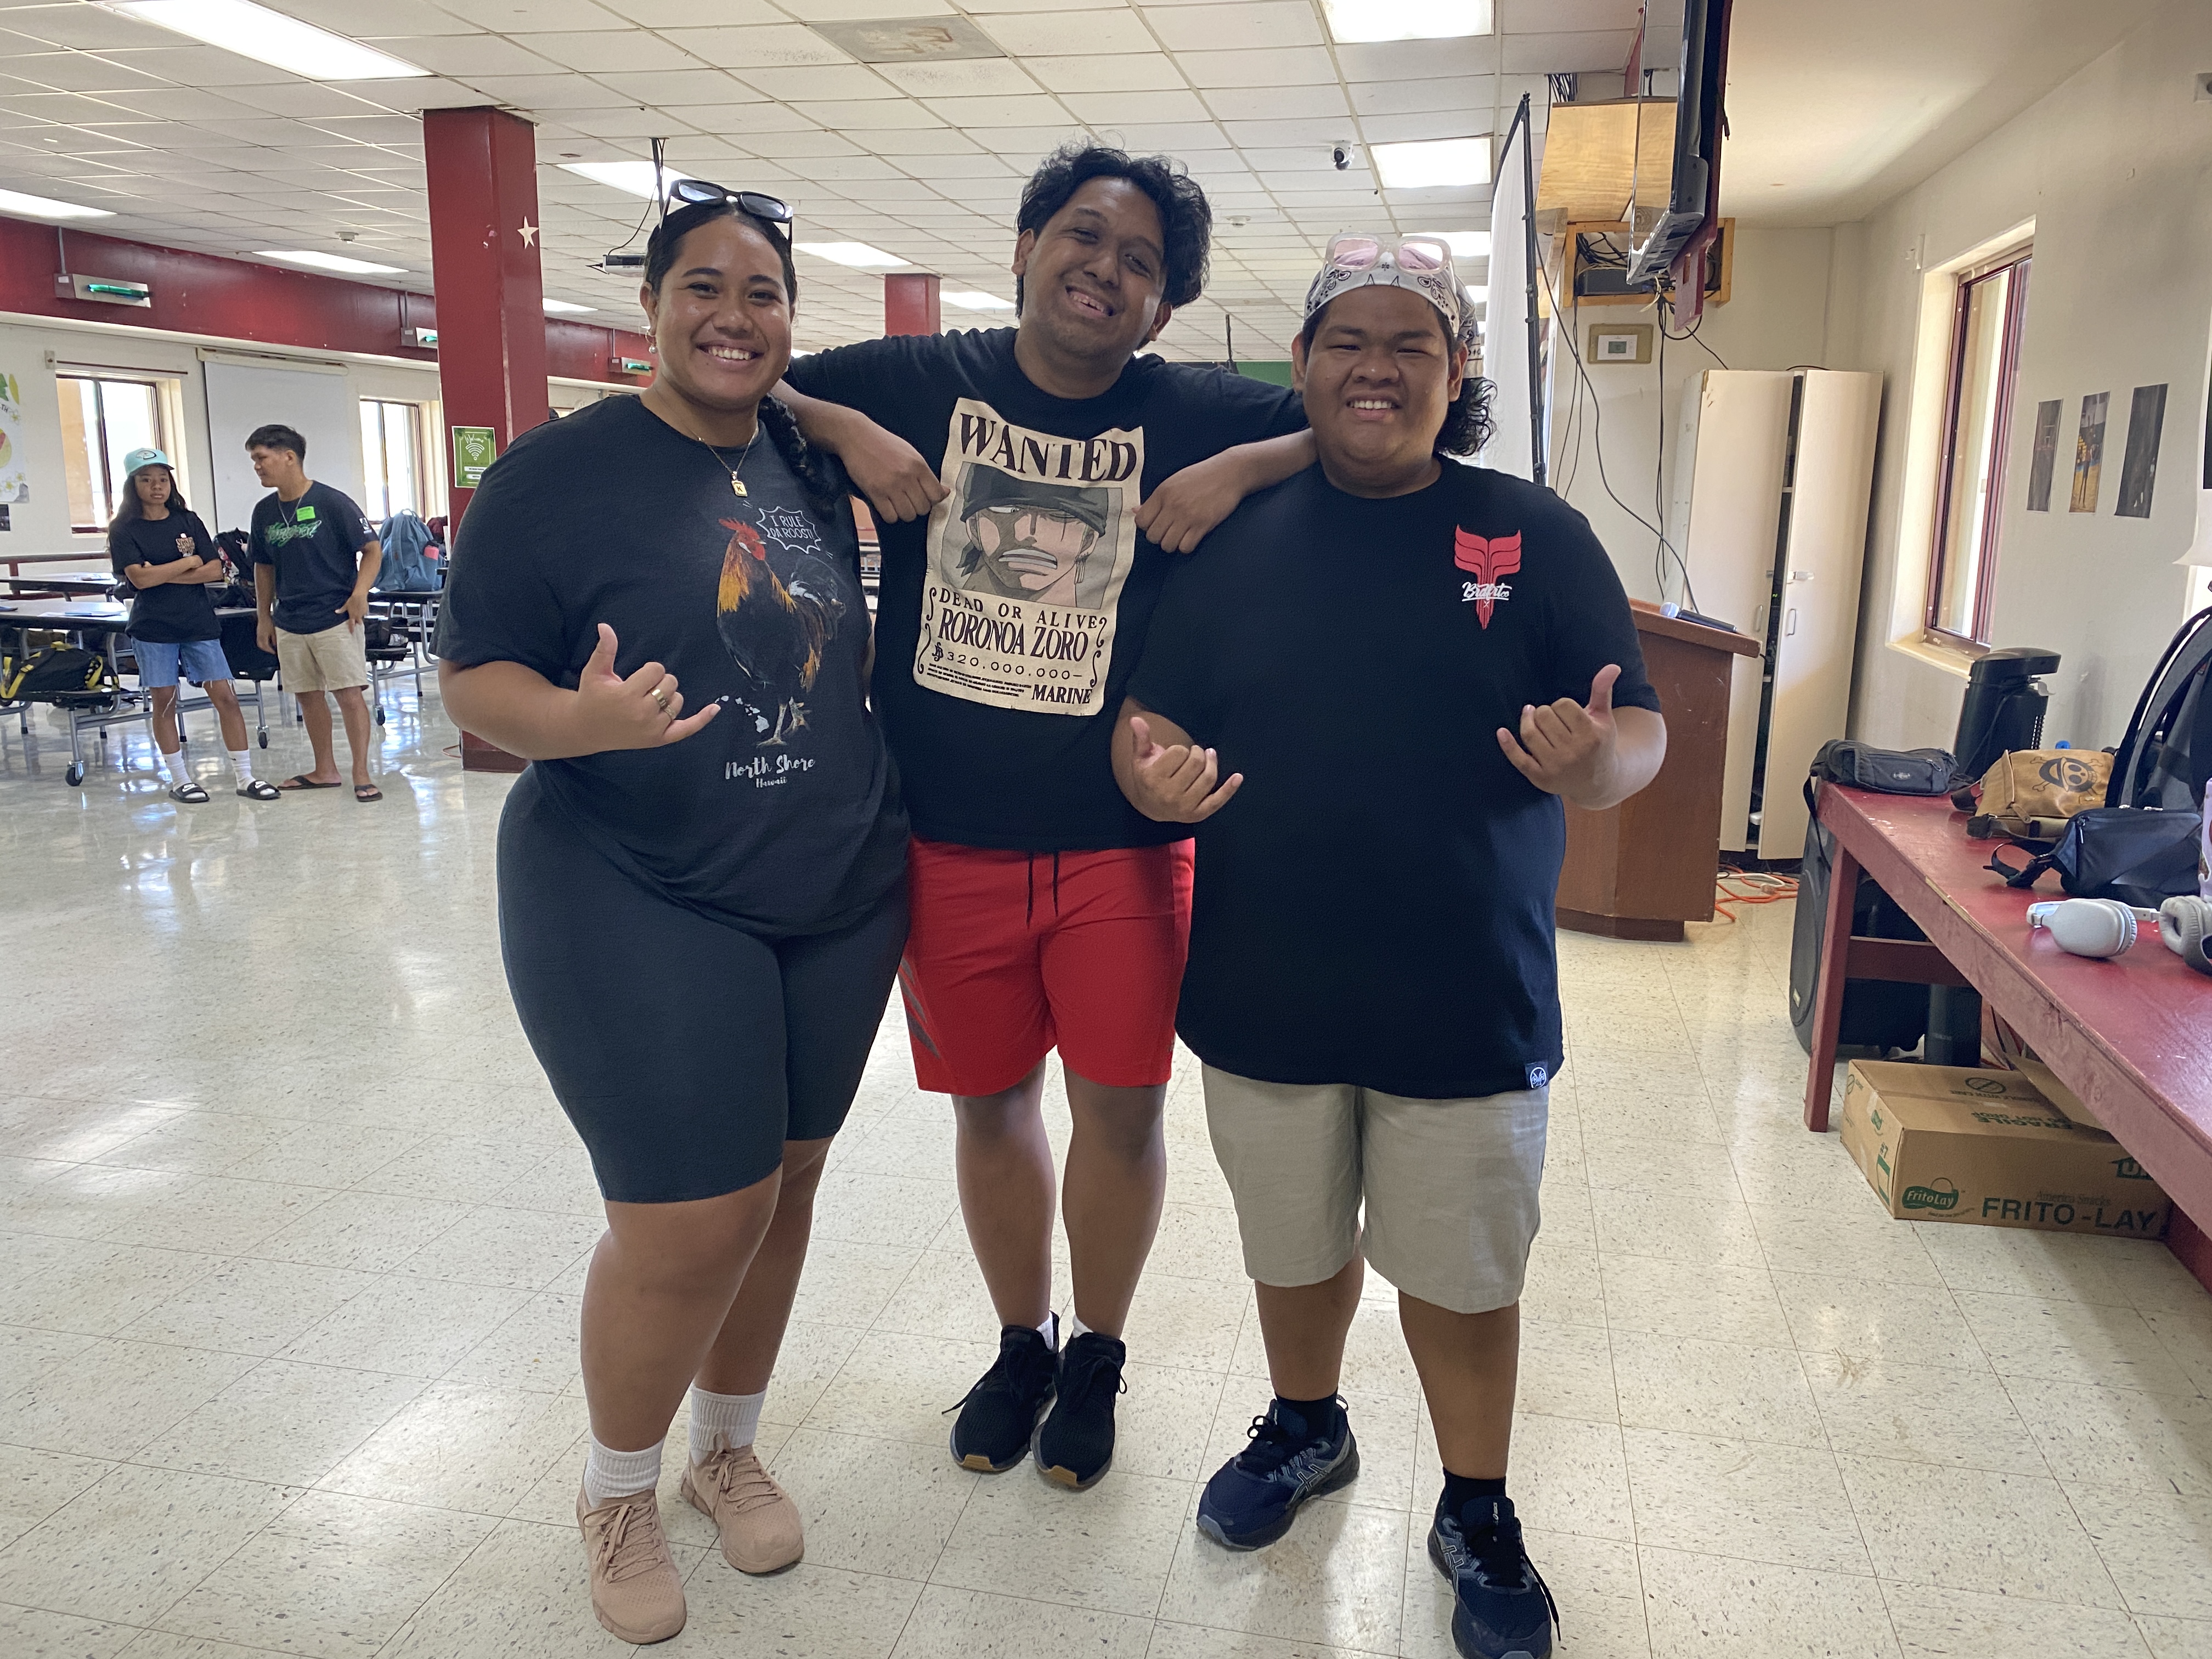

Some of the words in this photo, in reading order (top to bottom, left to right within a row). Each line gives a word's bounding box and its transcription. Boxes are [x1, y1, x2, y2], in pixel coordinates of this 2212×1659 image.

[960, 413, 1137, 482] WANTED
[769, 515, 779, 527] I
[779, 515, 804, 527] RULE
[769, 528, 783, 538] DA
[781, 528, 815, 540] ROOST!
[939, 588, 984, 612] DEAD
[998, 603, 1022, 619] OR
[1036, 610, 1098, 629] ALIVE
[938, 607, 1025, 656] RORONOA
[1030, 626, 1089, 662] ZORO
[1031, 684, 1093, 704] MARINE
[725, 757, 772, 780] North
[776, 754, 816, 774] Shore
[755, 776, 788, 788] Hawaii
